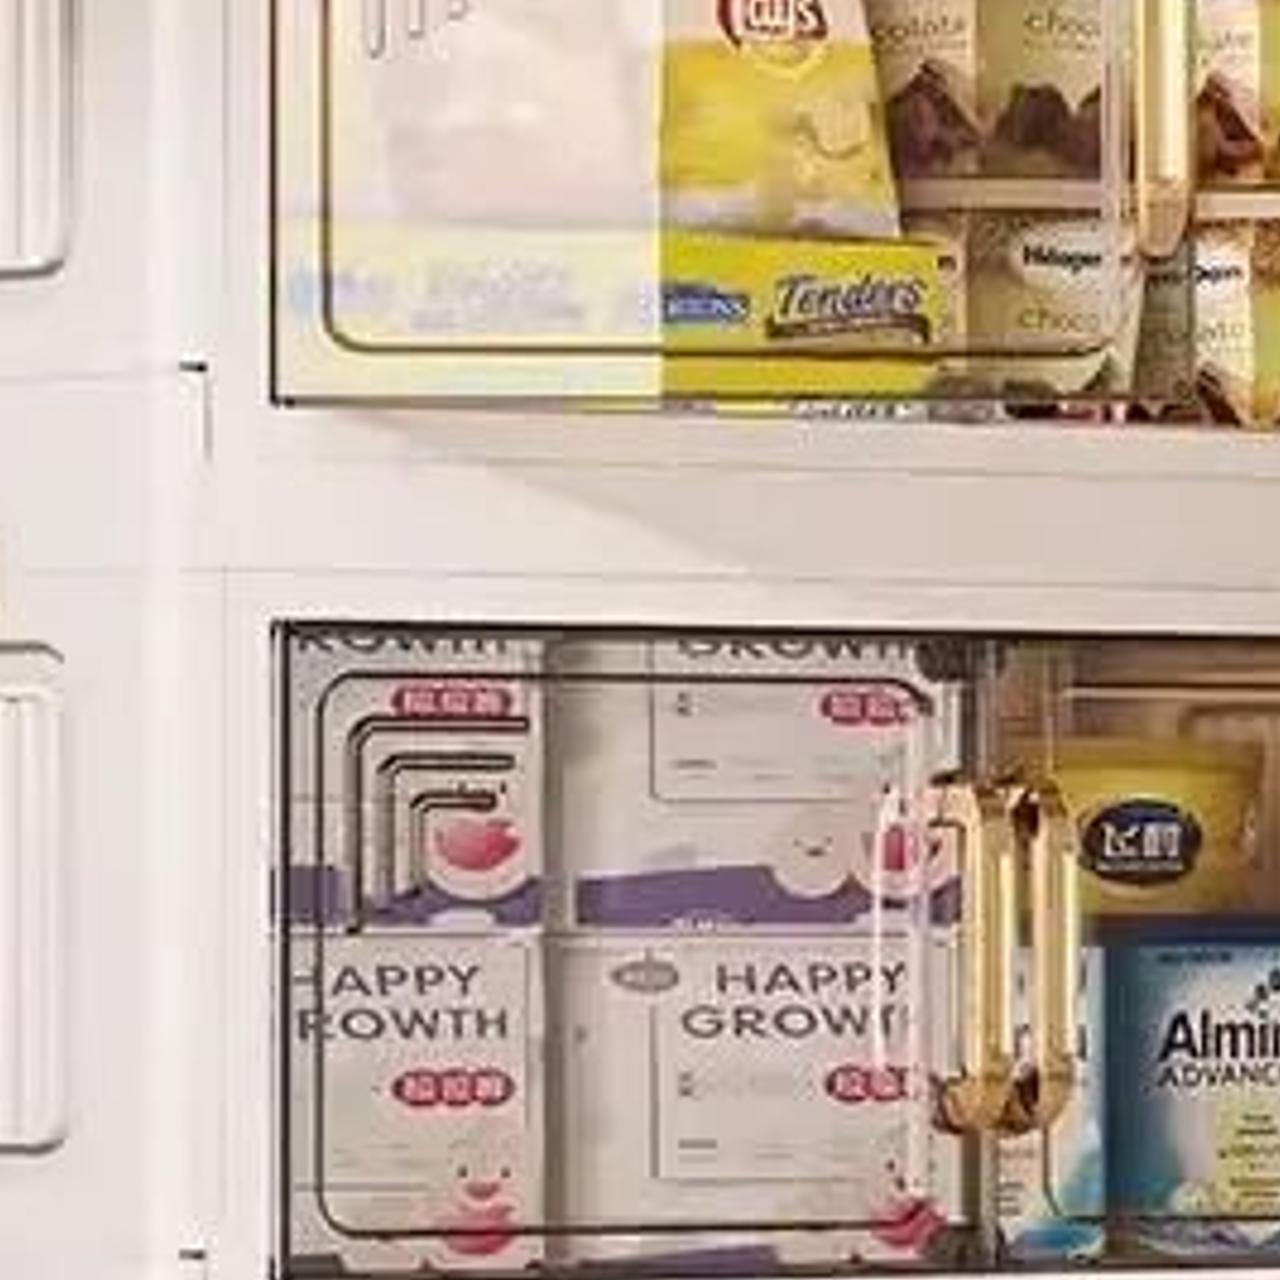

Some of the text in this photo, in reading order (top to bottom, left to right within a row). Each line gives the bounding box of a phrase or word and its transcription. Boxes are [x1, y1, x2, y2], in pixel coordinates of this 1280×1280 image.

[775, 271, 928, 318] Tenders
[717, 961, 907, 995] HAPPY
[681, 1005, 910, 1039] GROWT
